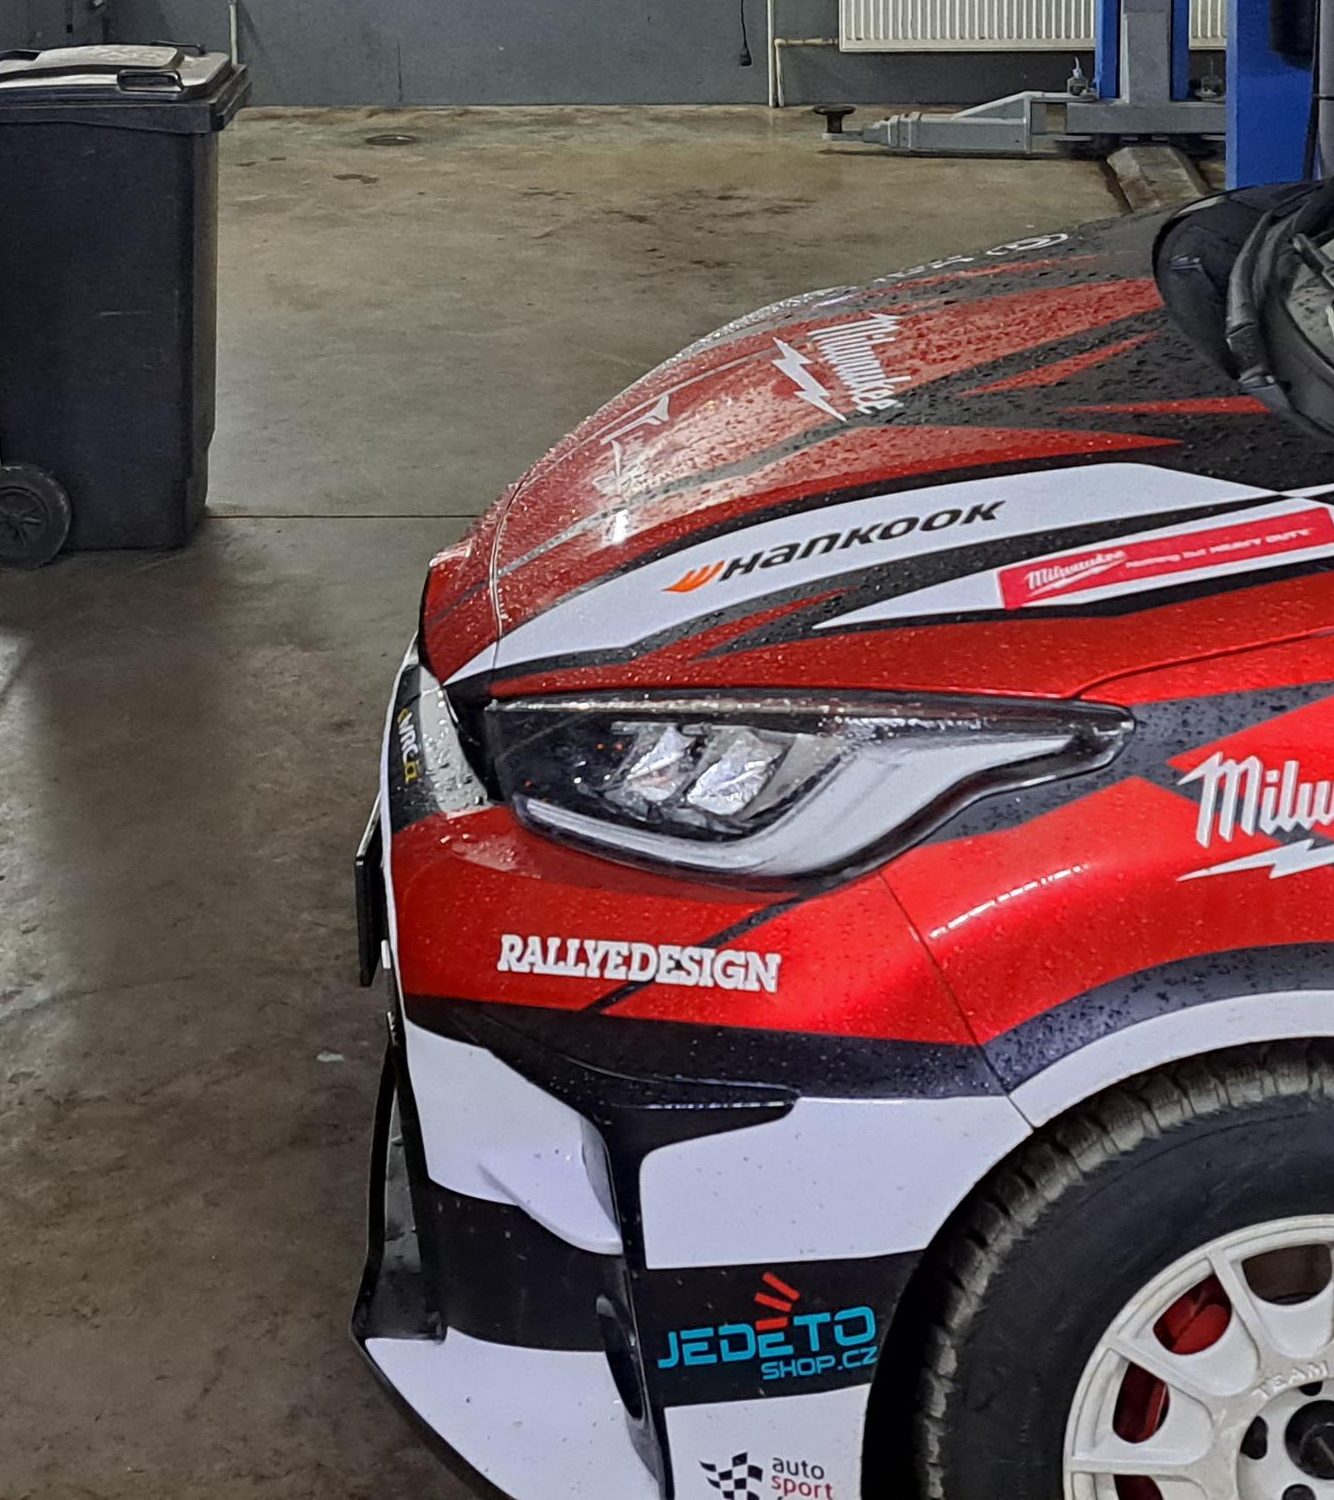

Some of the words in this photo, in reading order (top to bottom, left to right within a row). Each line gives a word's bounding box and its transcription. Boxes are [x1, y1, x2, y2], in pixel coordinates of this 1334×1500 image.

[1024, 549, 1127, 592] Milwaukee
[497, 933, 782, 993] RALLYEDESIGN
[657, 1305, 877, 1370] JEDETO
[760, 1346, 879, 1381] SHOP.CZ
[1250, 1359, 1329, 1400] TEAM
[771, 1475, 834, 1500] sport
[772, 1457, 825, 1481] auto
